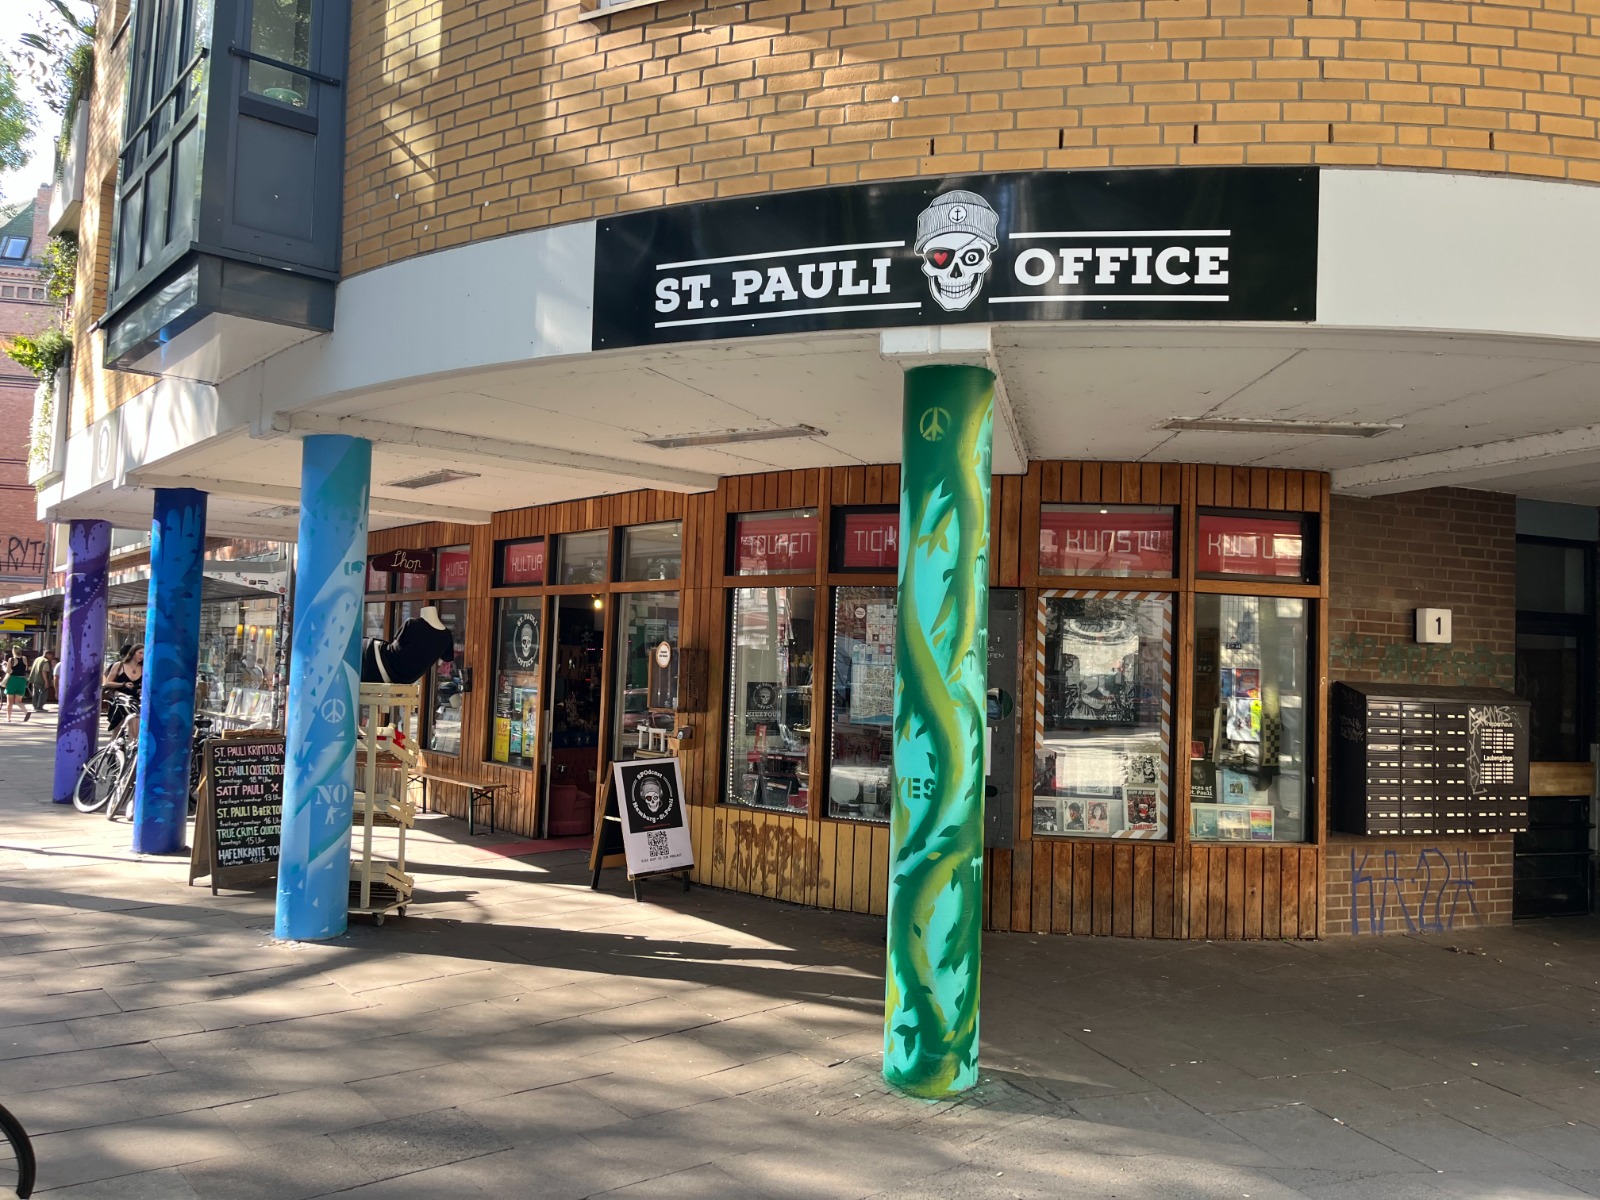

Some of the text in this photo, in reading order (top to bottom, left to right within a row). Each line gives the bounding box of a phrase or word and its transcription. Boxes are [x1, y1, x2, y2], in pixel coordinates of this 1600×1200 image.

[655, 246, 1229, 313] ST. PAULI OFFICE
[445, 560, 468, 577] KUNST
[511, 554, 543, 573] KULTUR
[1435, 616, 1442, 636] 1
[214, 743, 285, 758] ST. PAULI KRIMITOUR
[214, 766, 228, 777] ST.
[228, 765, 249, 777] PAULI
[216, 784, 264, 797] SATT PAULI
[314, 784, 348, 805] NO
[896, 776, 936, 801] YES
[216, 807, 230, 819] ST.
[230, 806, 251, 818] PAULI
[216, 827, 236, 842] TRUE
[236, 826, 259, 838] CRIME
[255, 836, 267, 844] Uhr
[218, 846, 266, 861] HAFENKANTE
